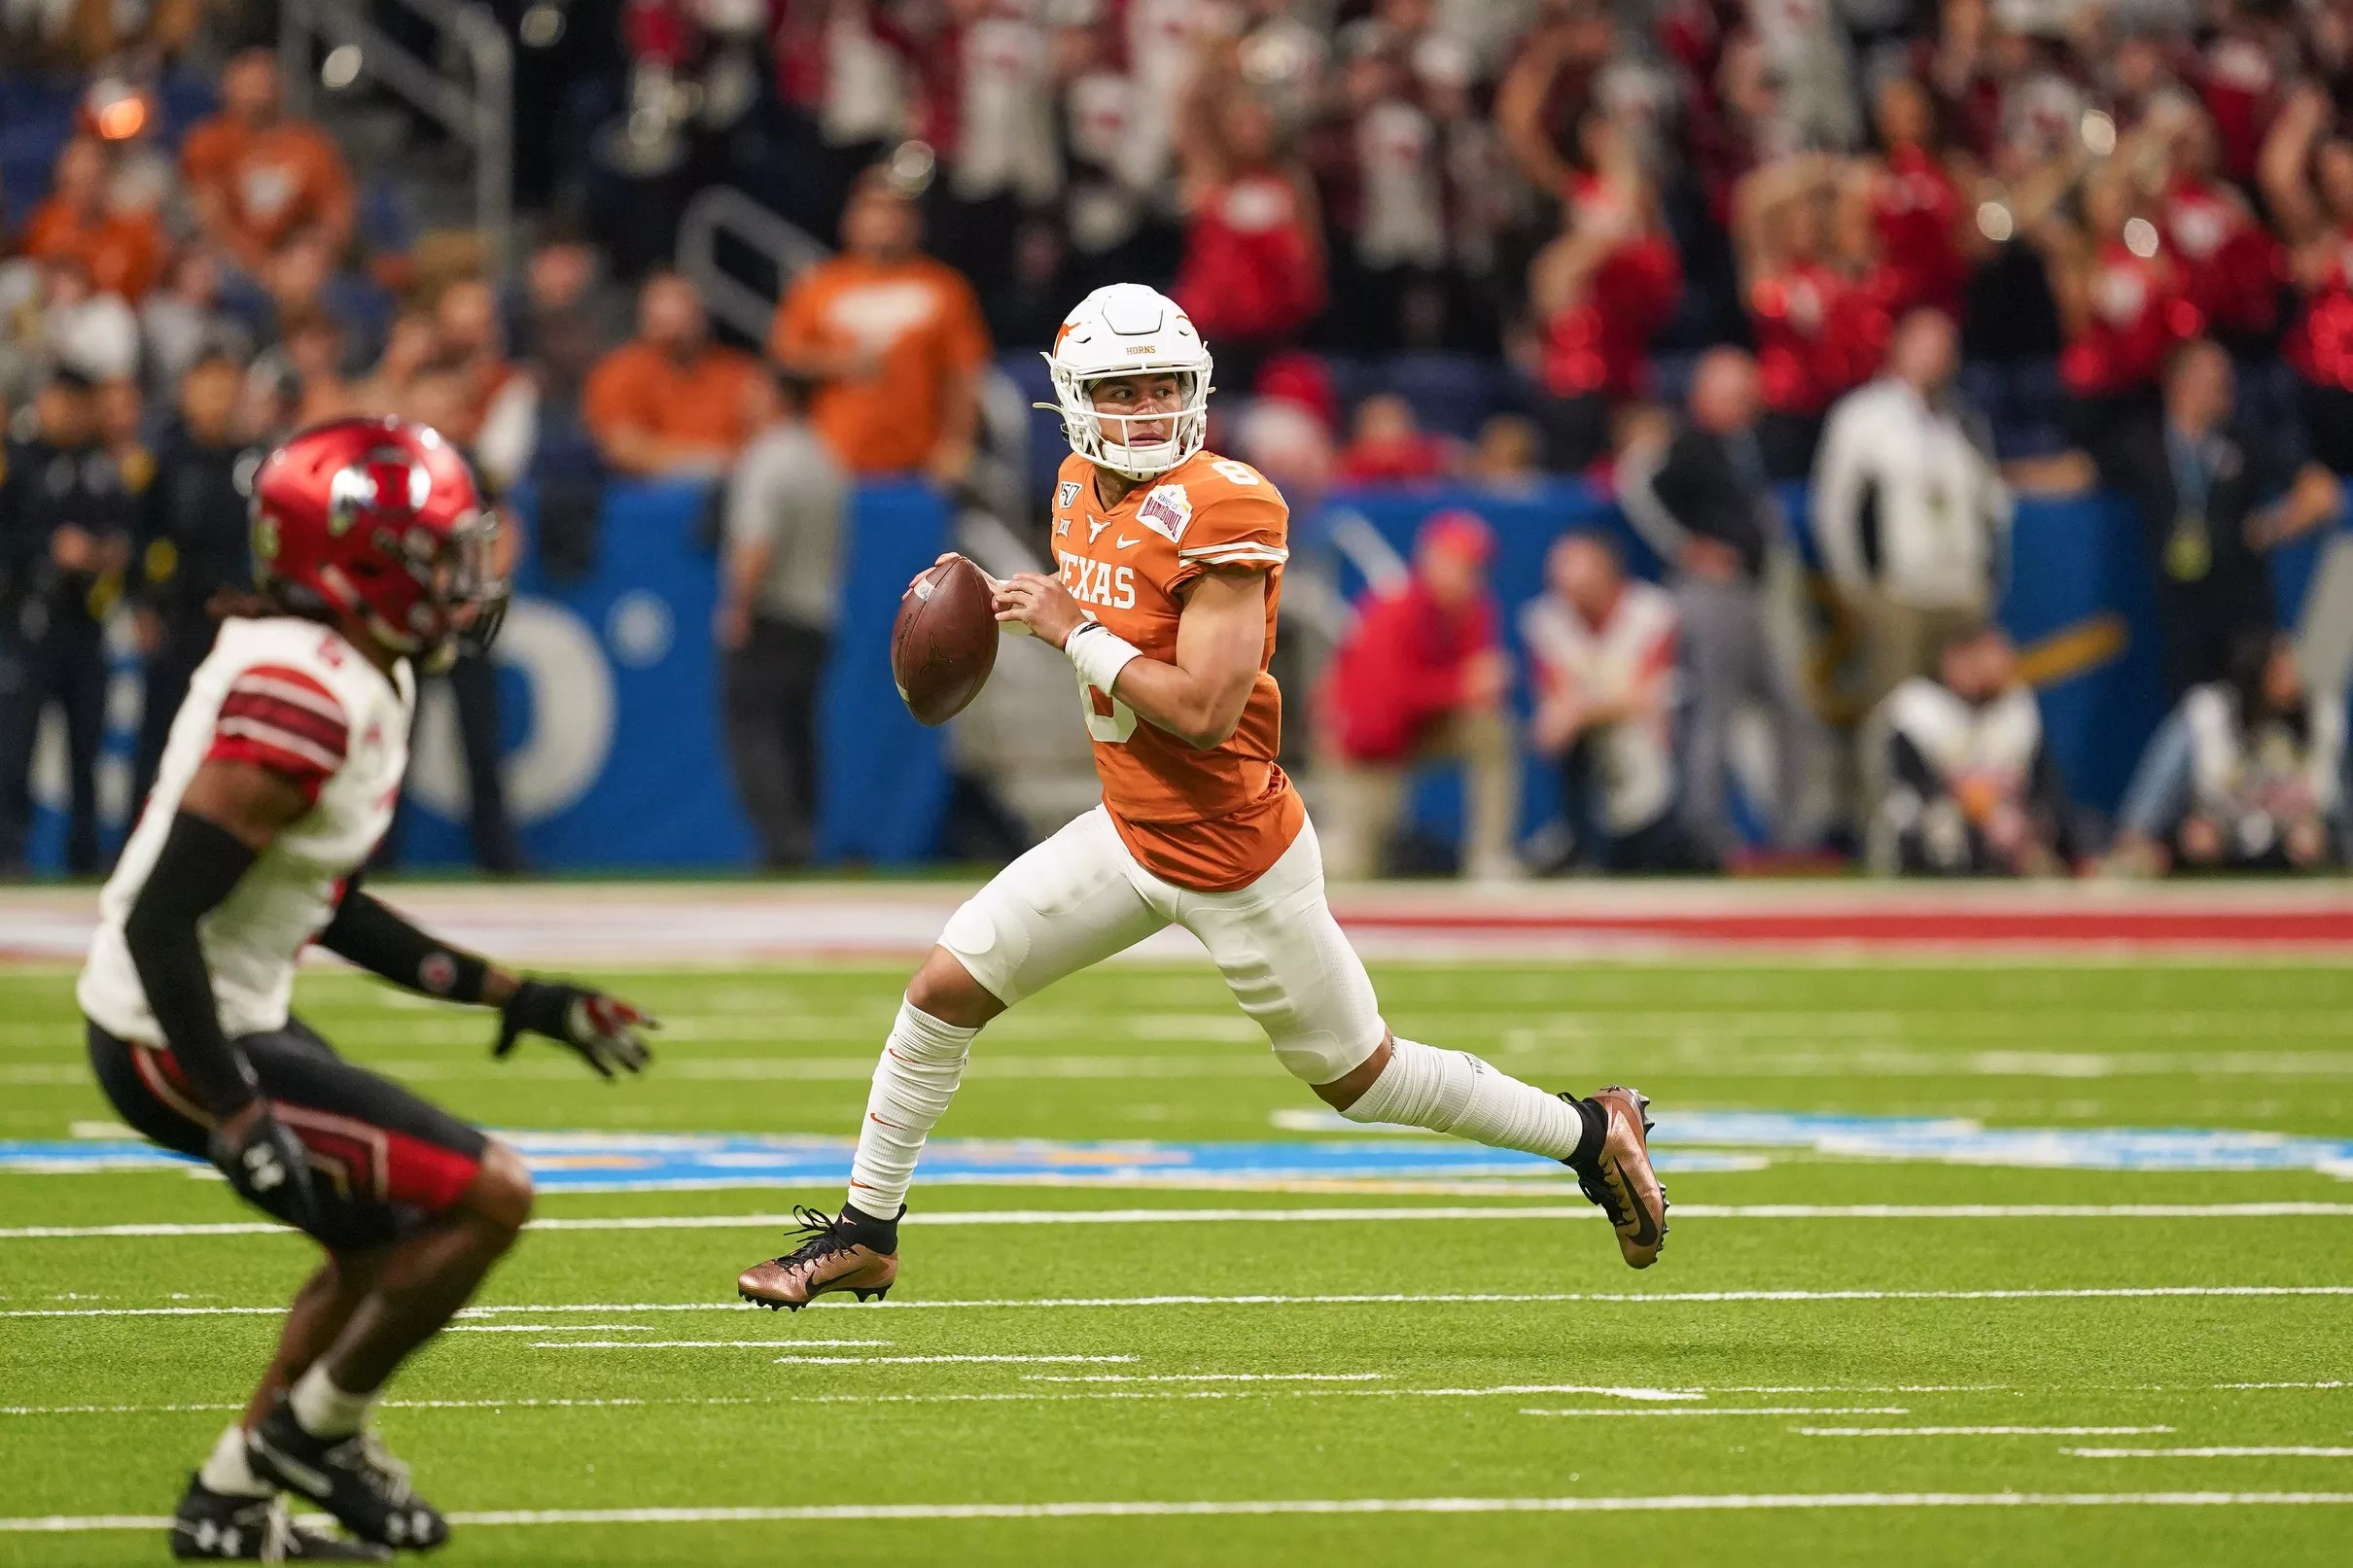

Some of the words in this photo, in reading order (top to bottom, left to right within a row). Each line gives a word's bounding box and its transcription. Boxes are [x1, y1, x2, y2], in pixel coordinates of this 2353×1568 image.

[1126, 345, 1156, 356] HORNS
[1212, 461, 1259, 485] 8
[1058, 549, 1136, 610] TEXAS
